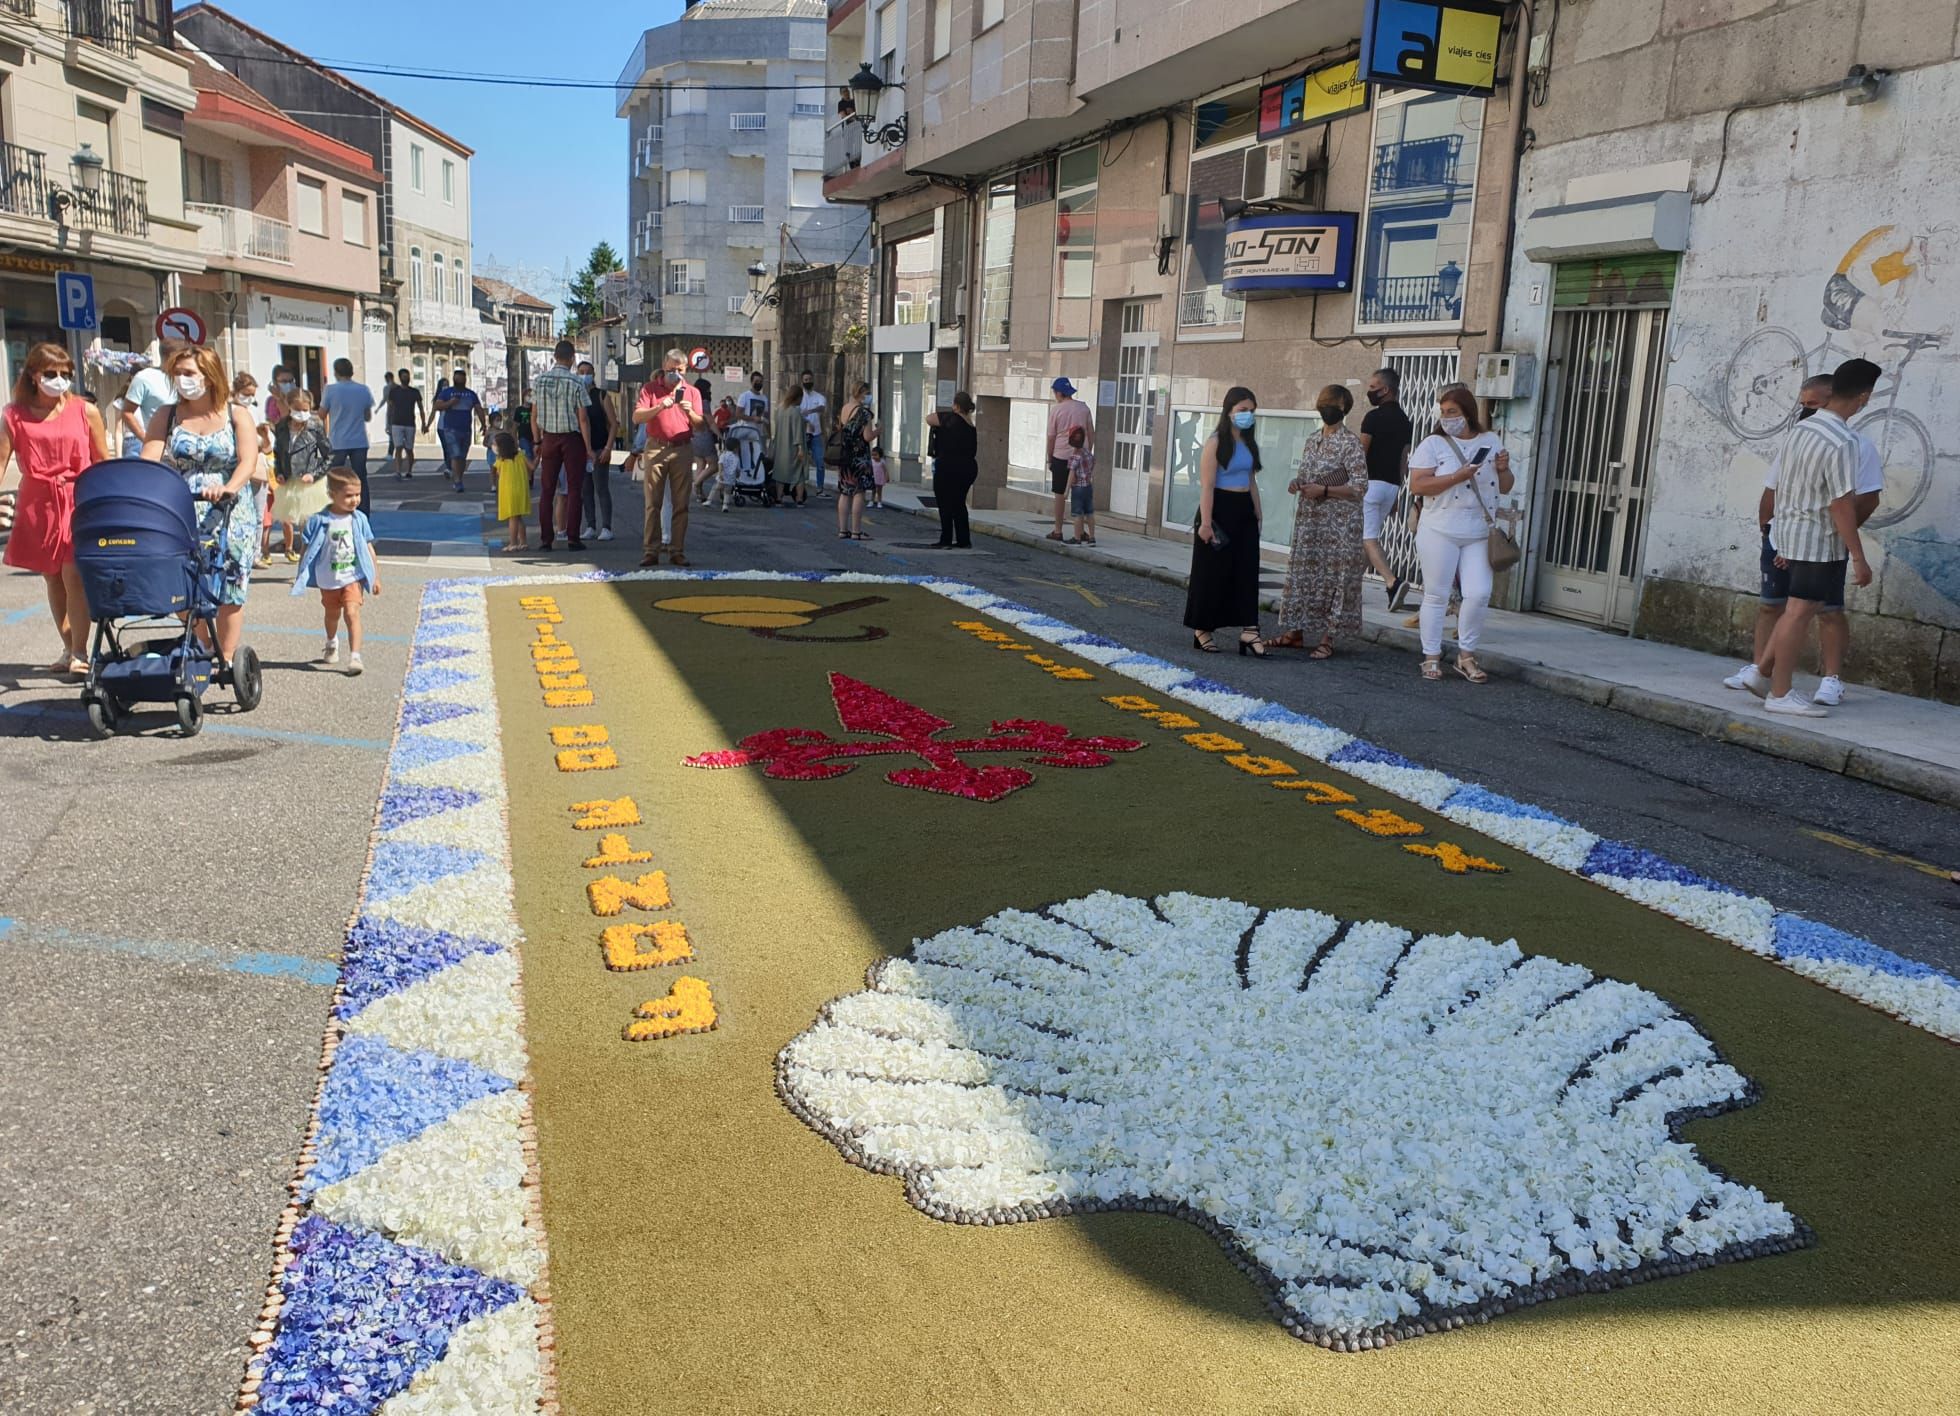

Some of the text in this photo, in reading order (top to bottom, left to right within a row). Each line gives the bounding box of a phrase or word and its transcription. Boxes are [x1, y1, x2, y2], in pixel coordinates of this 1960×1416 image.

[1397, 31, 1434, 79] a
[1447, 45, 1473, 58] viajes
[1327, 80, 1348, 95] viajes
[65, 279, 87, 323] P
[1533, 286, 1539, 302] 7
[549, 724, 620, 773] DO
